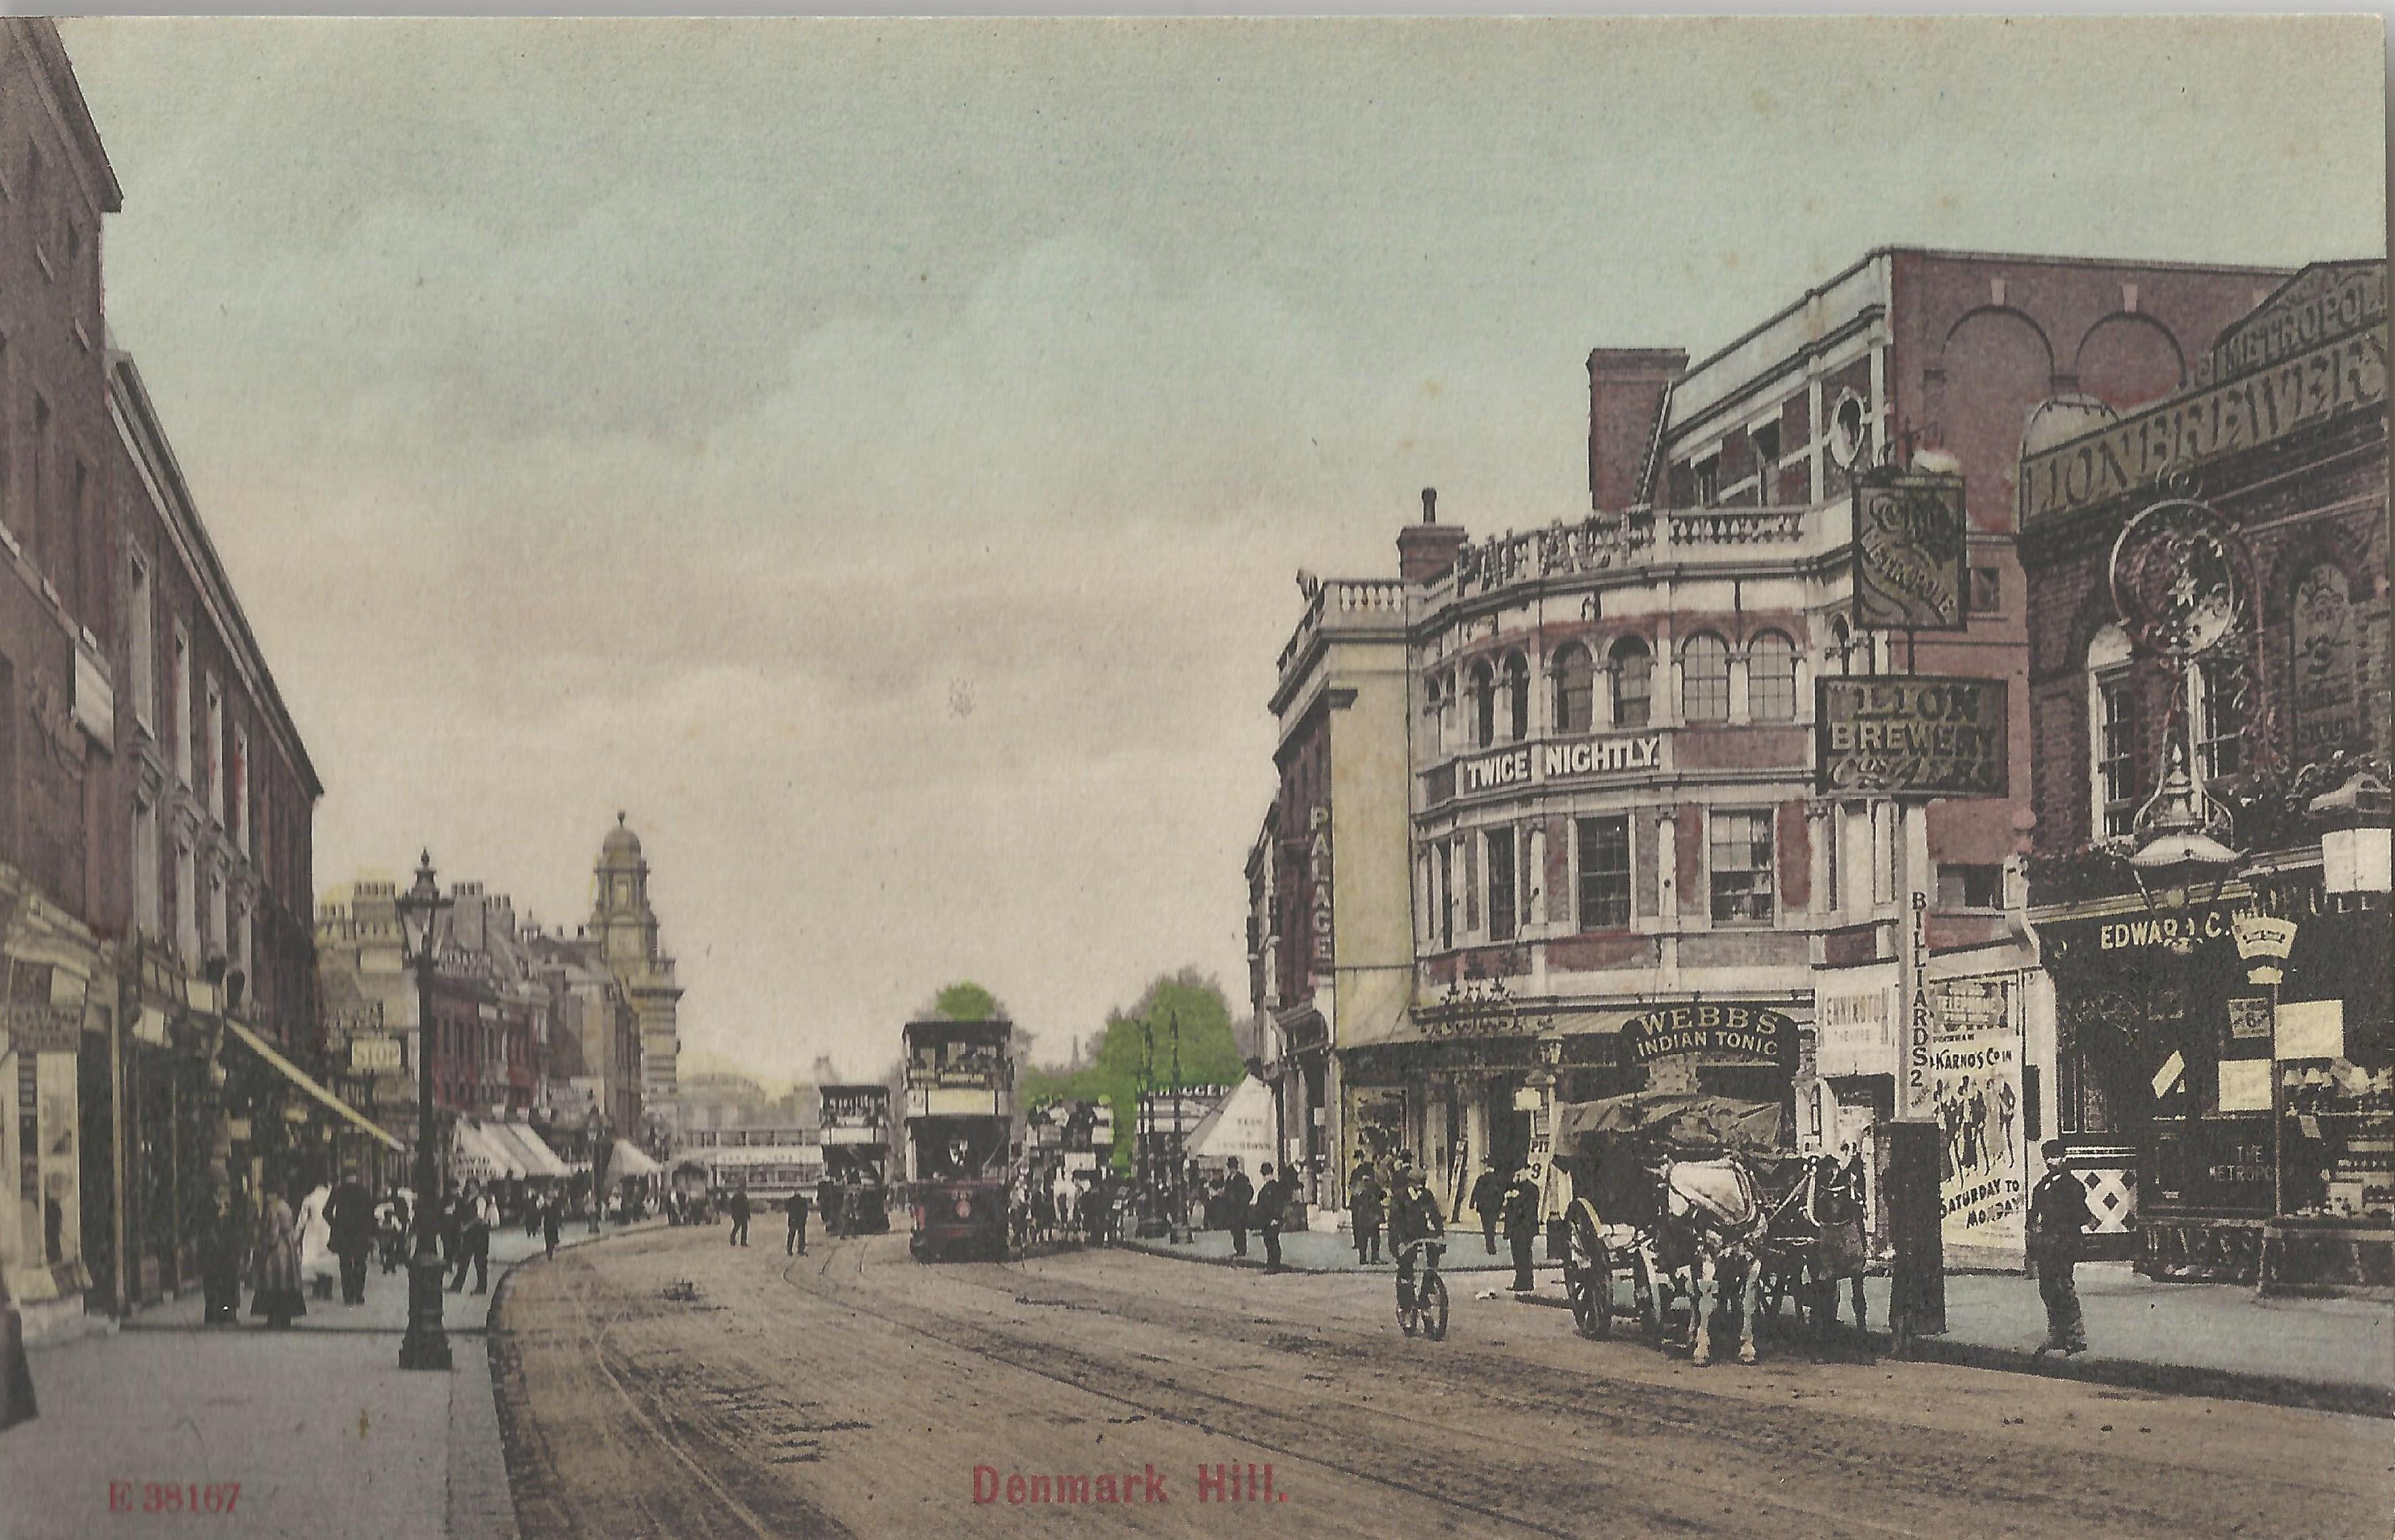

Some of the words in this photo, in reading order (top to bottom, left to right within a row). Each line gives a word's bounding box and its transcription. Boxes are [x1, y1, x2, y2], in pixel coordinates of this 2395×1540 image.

[2137, 333, 2388, 472] BREWER
[1854, 679, 1982, 723] LION
[1467, 750, 1528, 790] TWICE
[1545, 736, 1660, 776] NIGHTLY.
[1831, 721, 1996, 758] BREWERY
[1310, 802, 1332, 961] PALACE
[1911, 892, 1928, 1067] BILLIARDS
[1637, 1031, 1708, 1057] INDIAN
[1716, 1032, 1779, 1056] TONIC
[1939, 1178, 2001, 1219] SATURDAY
[2004, 1179, 2021, 1193] TO
